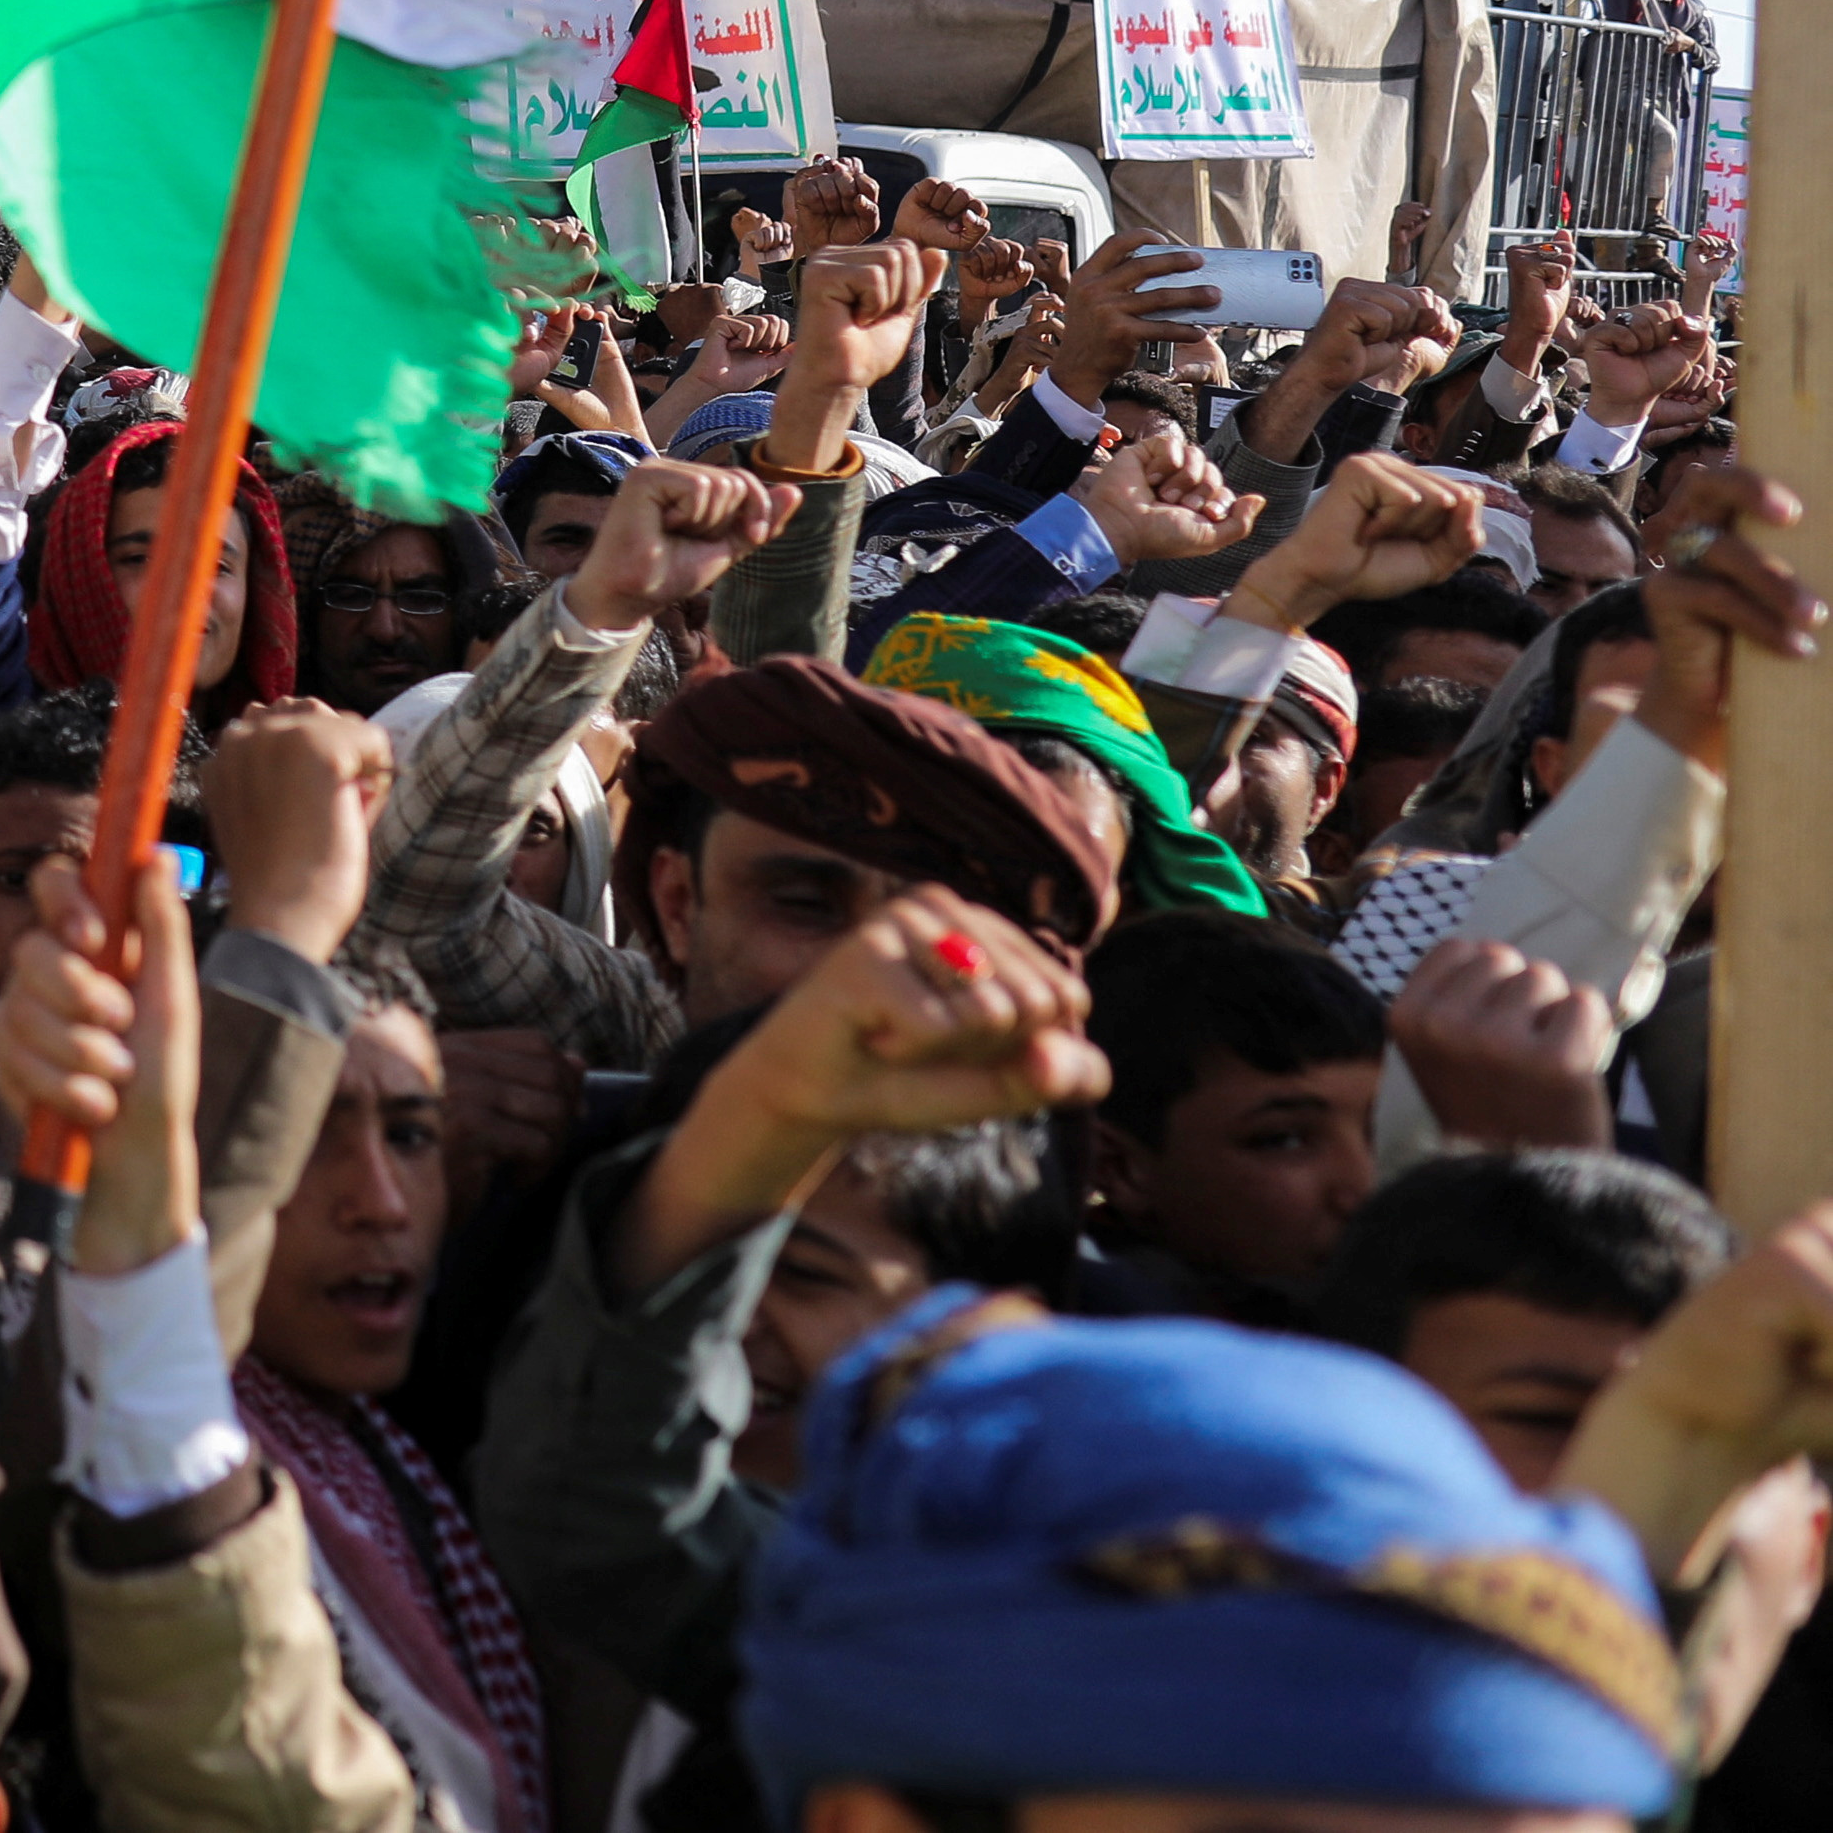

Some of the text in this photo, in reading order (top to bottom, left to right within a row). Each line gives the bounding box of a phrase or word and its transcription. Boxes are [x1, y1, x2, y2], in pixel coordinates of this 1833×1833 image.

[694, 7, 775, 55] اللعنة
[1114, 9, 1270, 55] اللعنة على اليهود
[679, 69, 785, 145] النص
[1121, 61, 1282, 130] النصر للإسلام
